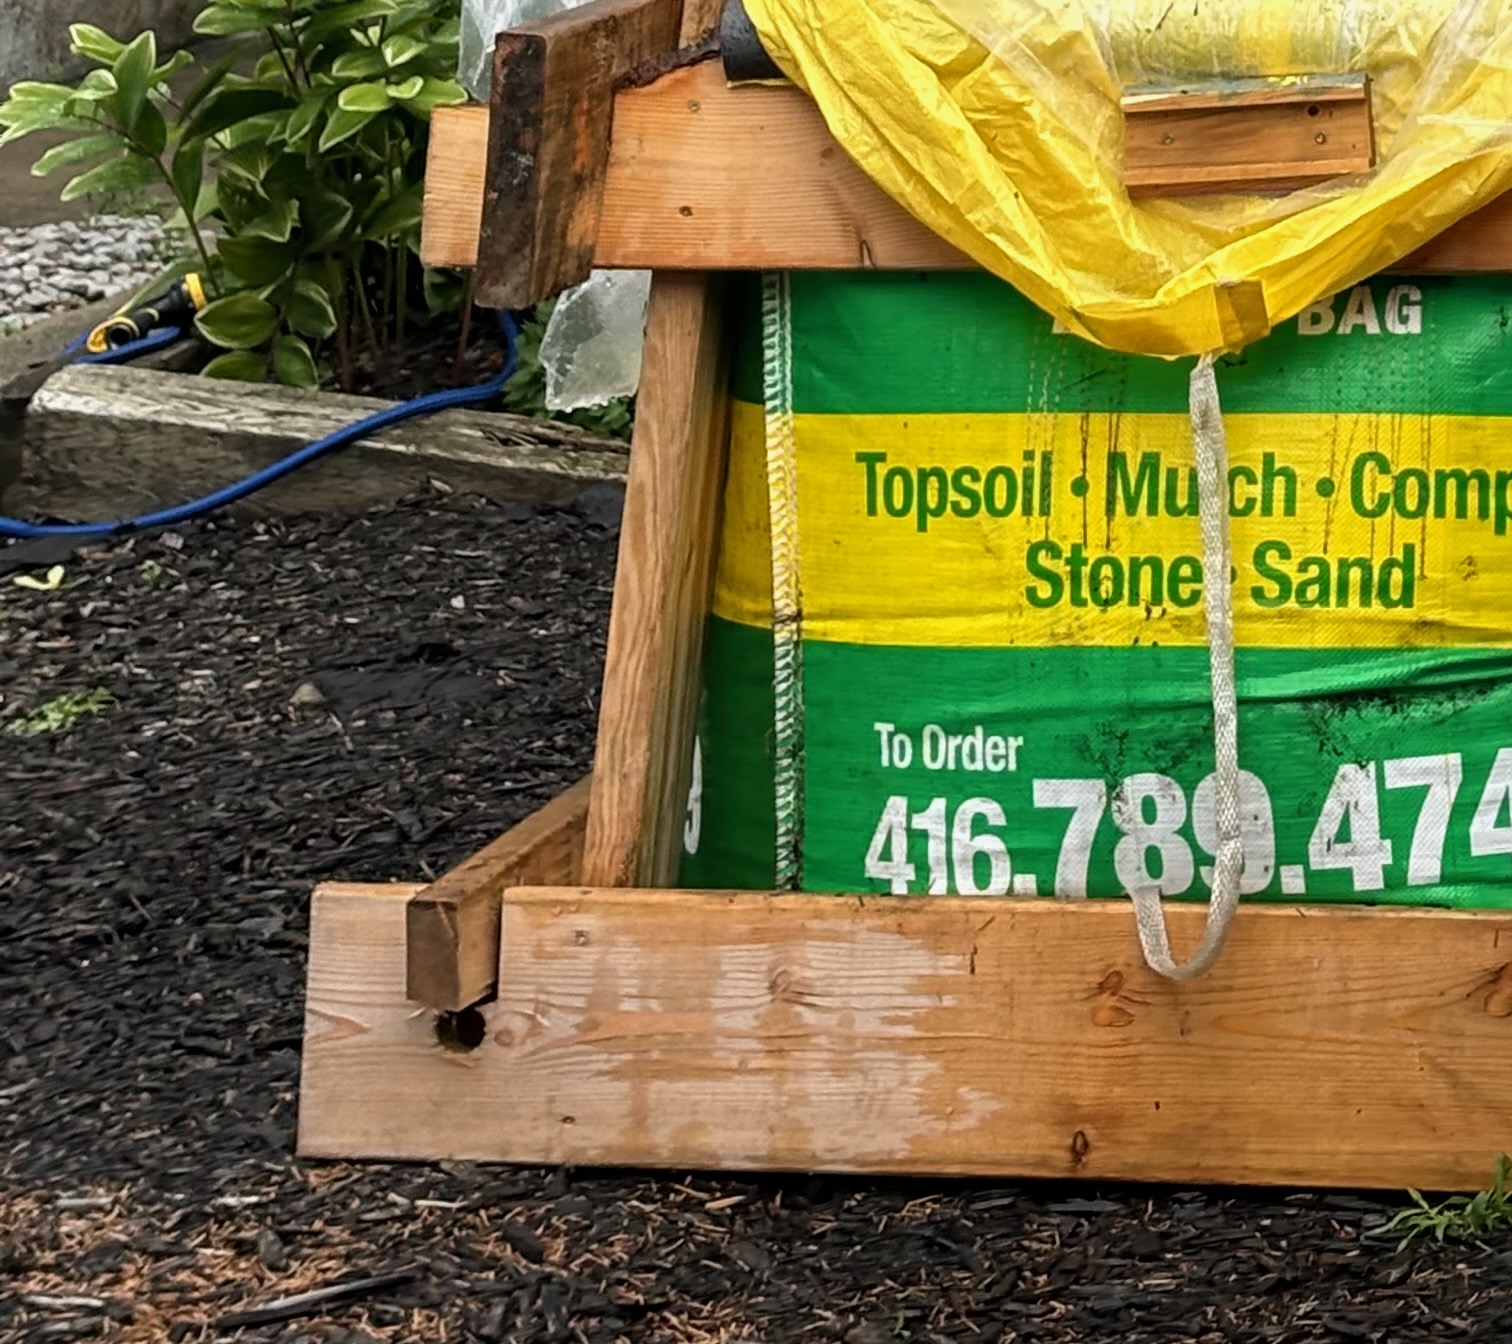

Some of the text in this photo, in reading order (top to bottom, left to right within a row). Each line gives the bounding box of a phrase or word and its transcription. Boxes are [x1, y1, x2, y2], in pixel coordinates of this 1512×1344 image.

[1297, 284, 1422, 336] BAG
[855, 450, 1053, 533] Topsoil
[1106, 451, 1297, 518] Much
[1025, 539, 1415, 609] Stone Sand
[874, 722, 1023, 772] To Order
